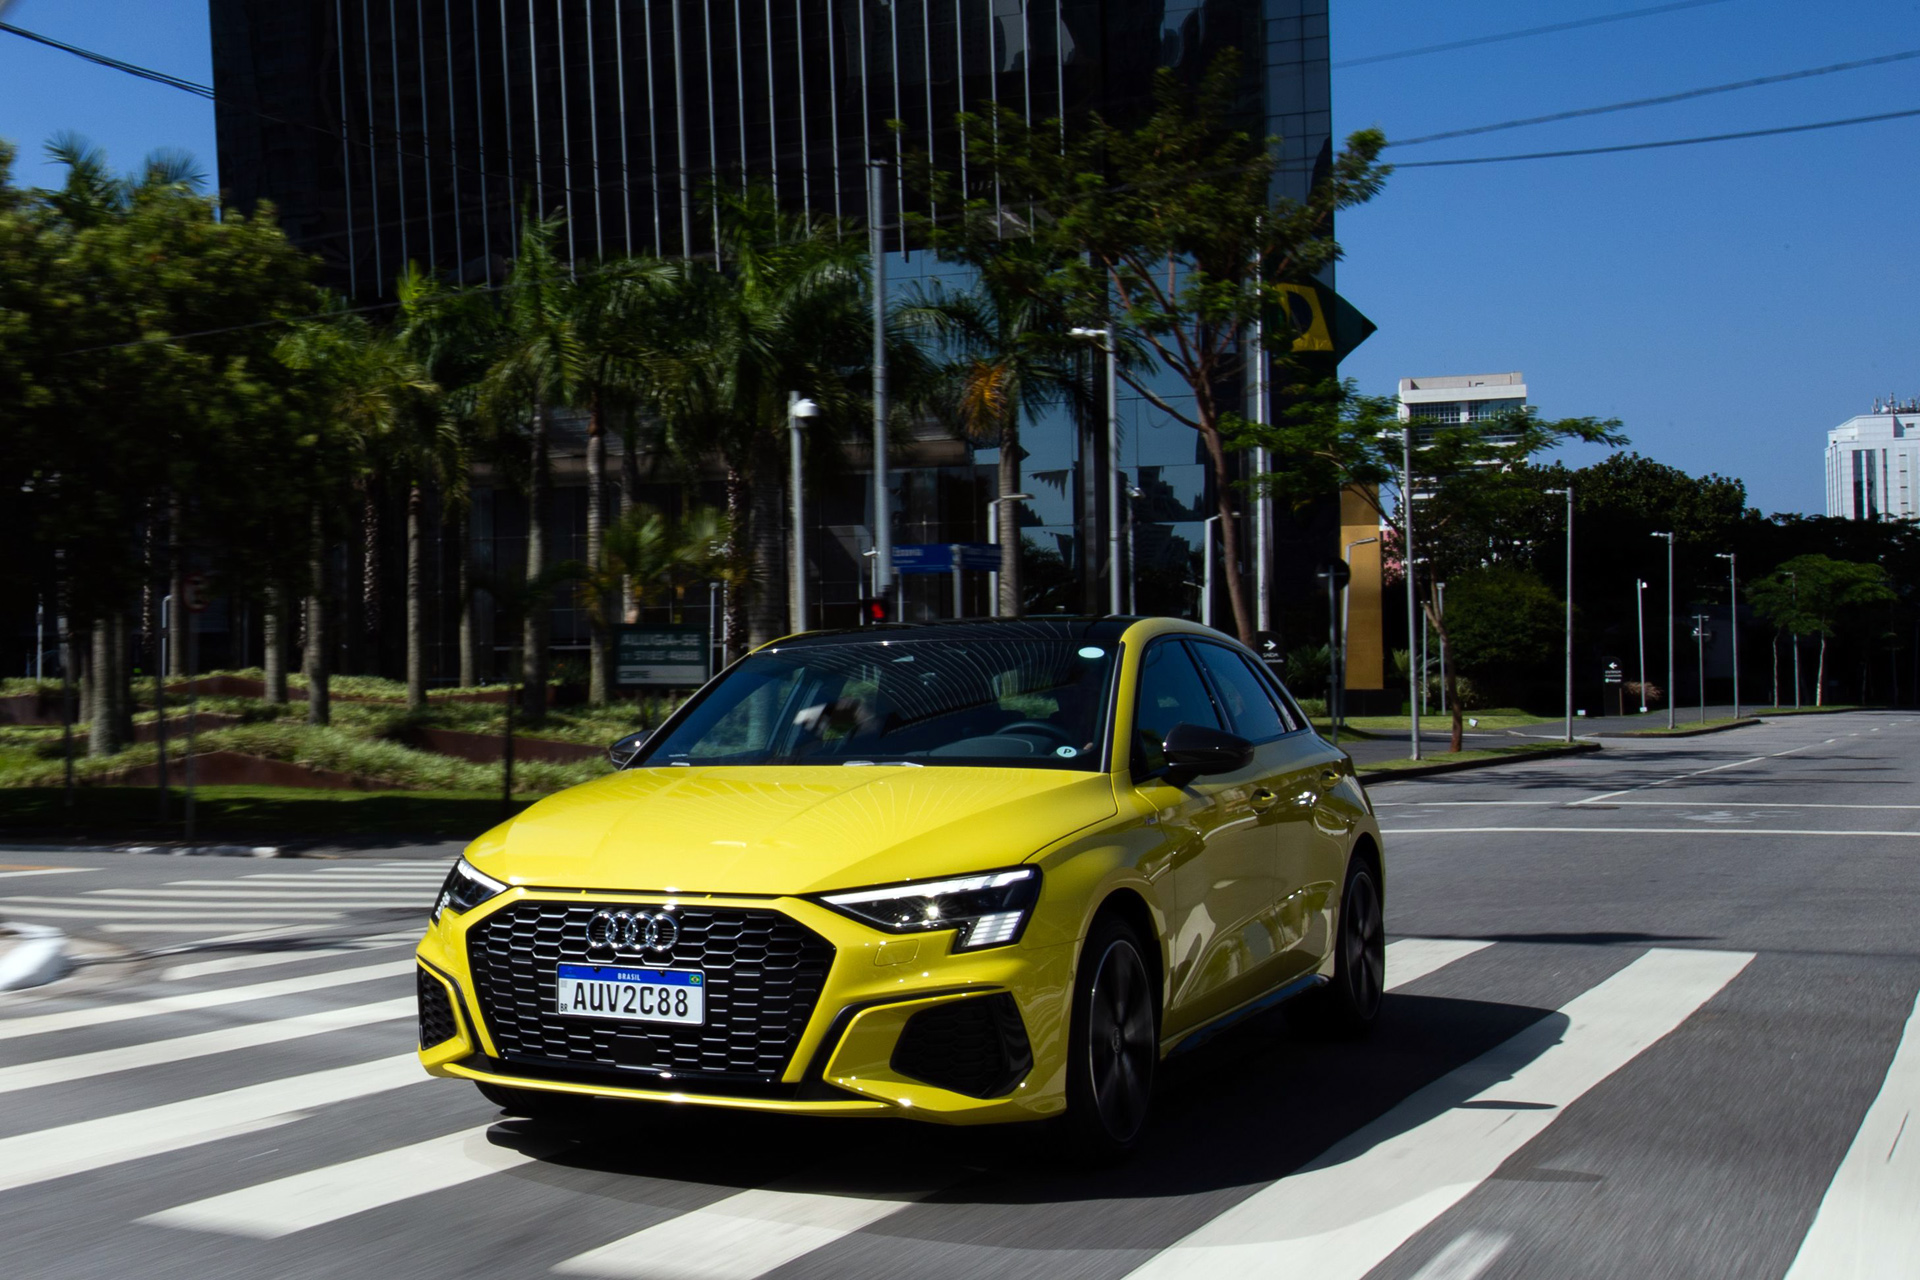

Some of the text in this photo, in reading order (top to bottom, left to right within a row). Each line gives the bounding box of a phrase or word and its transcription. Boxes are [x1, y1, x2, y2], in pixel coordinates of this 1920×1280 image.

[620, 633, 701, 646] ALUGA-SE
[617, 973, 641, 981] BRASIL
[573, 982, 688, 1017] AUV2C88
[560, 1003, 568, 1012] BR
